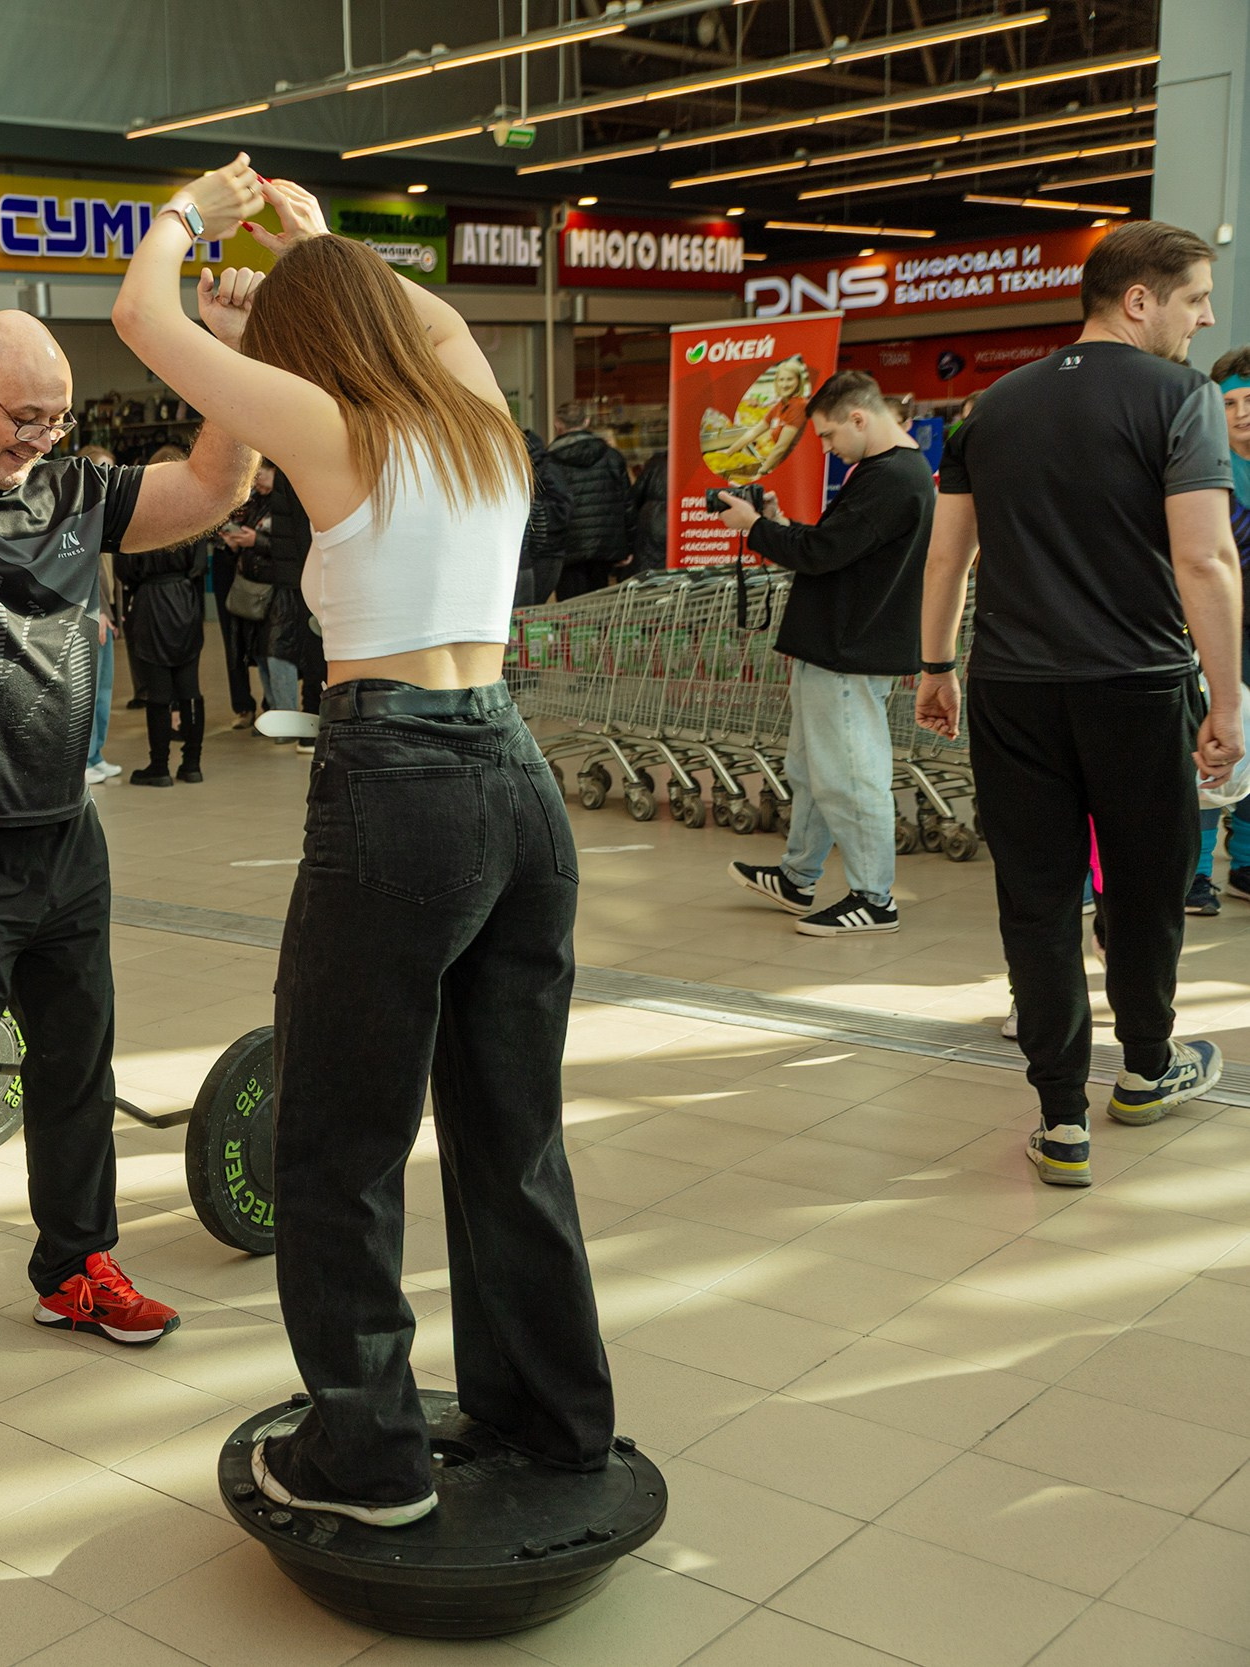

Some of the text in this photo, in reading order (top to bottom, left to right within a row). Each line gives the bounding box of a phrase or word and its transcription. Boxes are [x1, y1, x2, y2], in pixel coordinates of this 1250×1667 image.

[460, 222, 543, 267] АТЕЛЬЕ
[569, 227, 745, 274] МНОГО МЕБЕЛИ
[895, 244, 1042, 283] ЦИФРОВАЯ И
[744, 264, 889, 318] DNS
[894, 274, 995, 305] БЫТОВАЯ
[681, 511, 688, 522] В
[4, 1089, 21, 1108] KG
[236, 1091, 256, 1117] 10
[246, 1078, 264, 1101] KG
